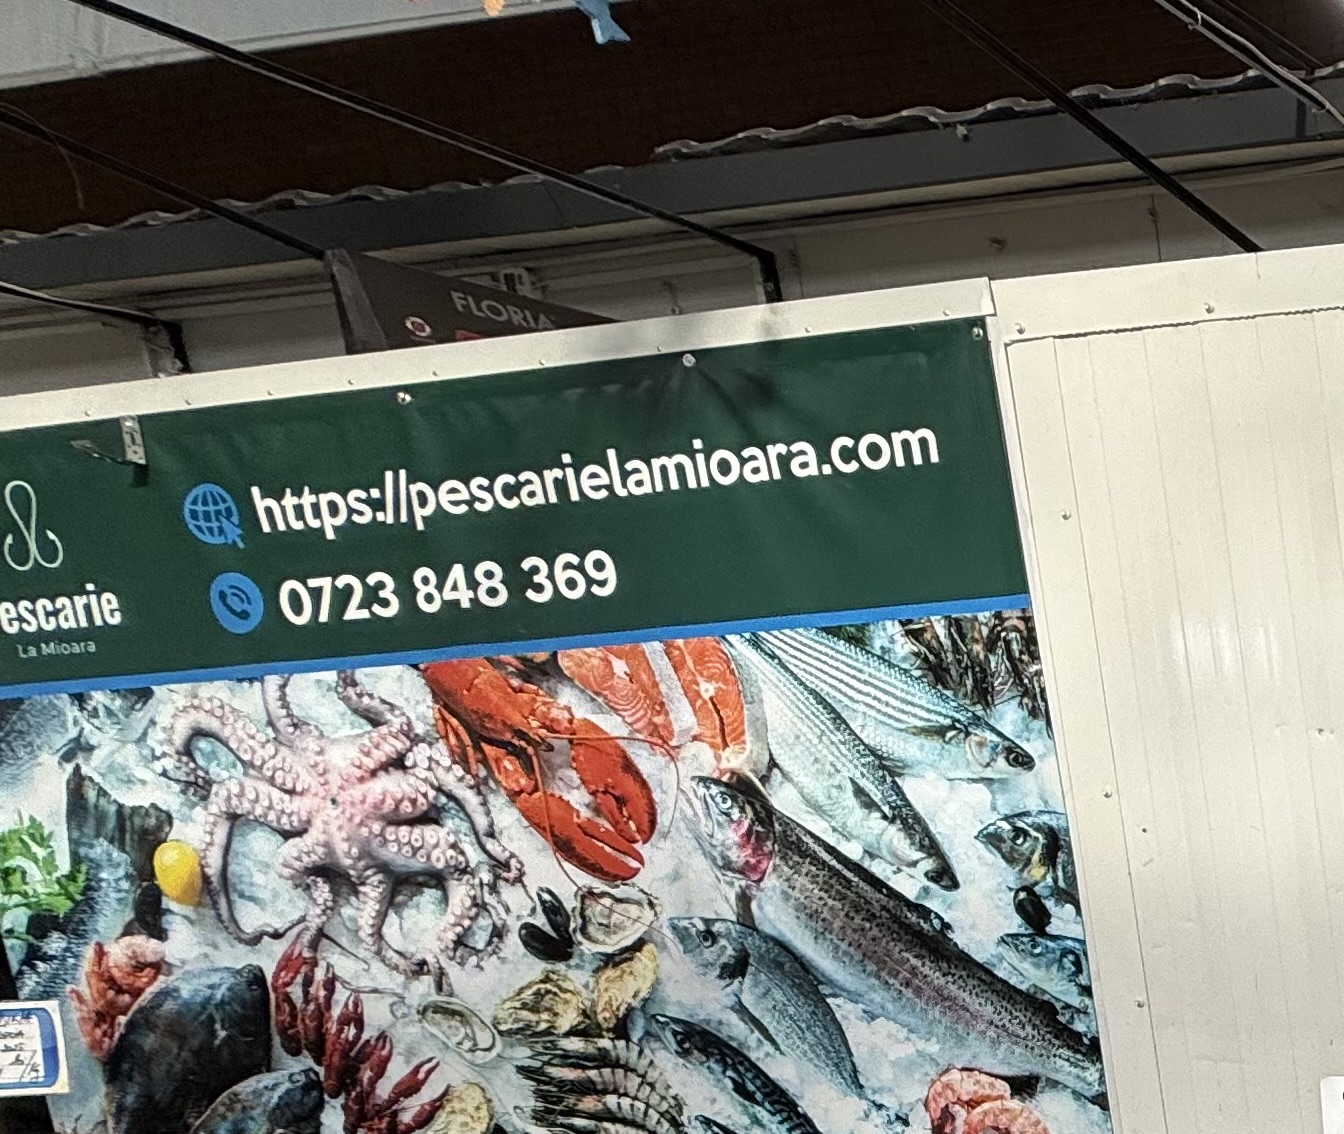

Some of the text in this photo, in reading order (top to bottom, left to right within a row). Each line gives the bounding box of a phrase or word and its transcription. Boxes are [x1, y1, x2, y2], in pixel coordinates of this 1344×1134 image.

[250, 426, 940, 540] https://pescarielamioara.com
[278, 549, 618, 626] 0723 848 369
[16, 639, 97, 659] La Mioara
